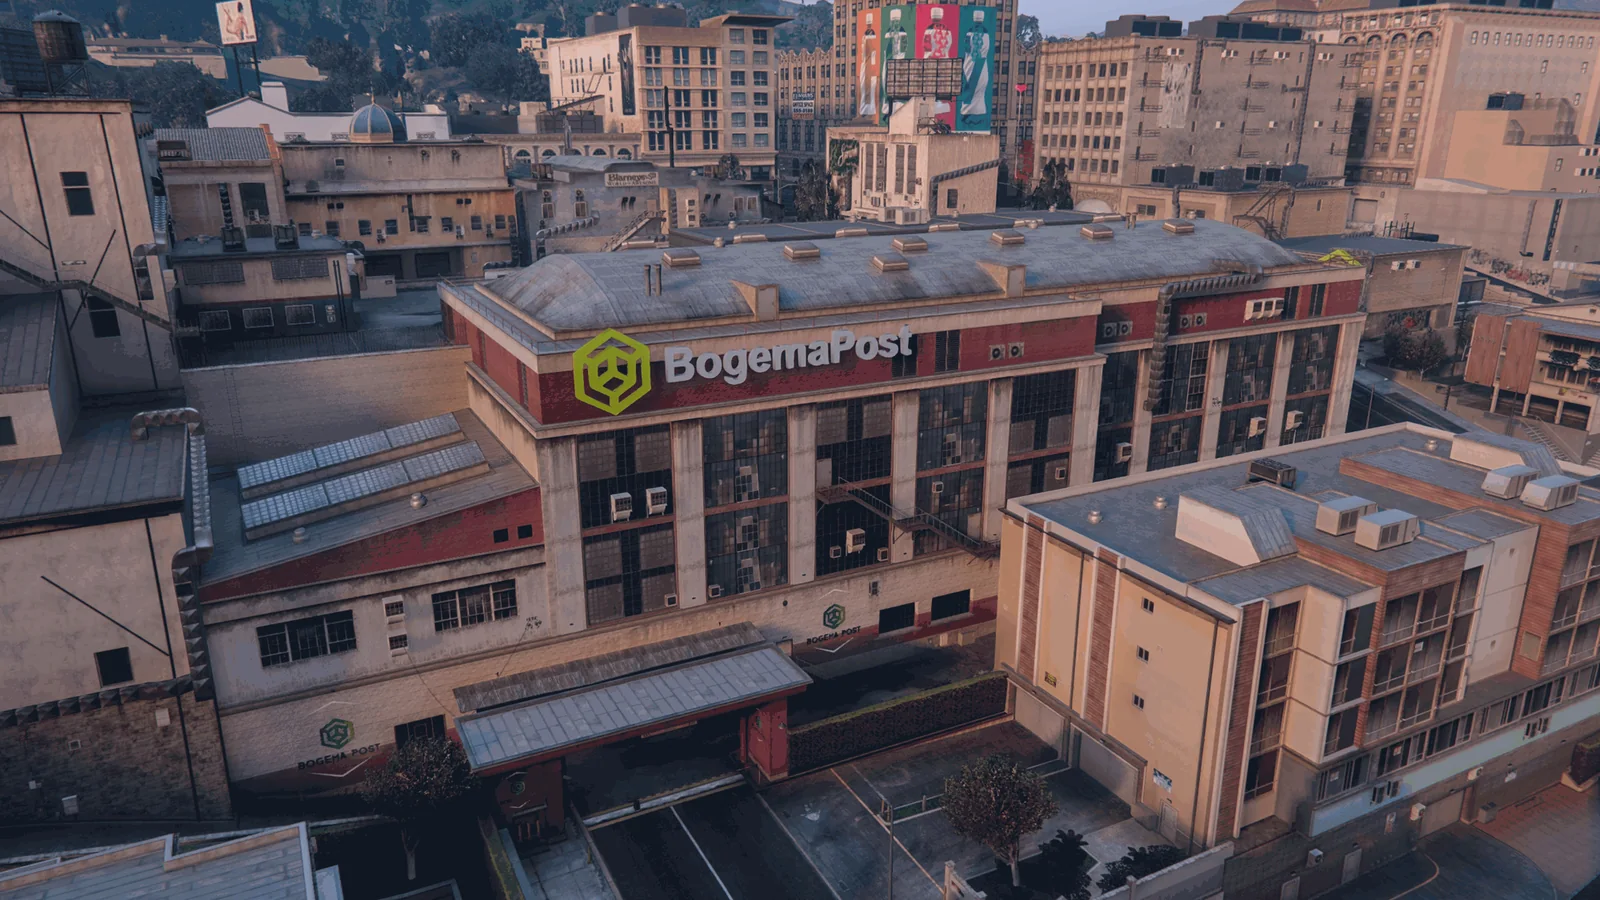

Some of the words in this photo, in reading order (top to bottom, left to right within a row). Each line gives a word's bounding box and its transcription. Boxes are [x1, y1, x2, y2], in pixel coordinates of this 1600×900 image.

[664, 324, 913, 386] BogemaPost
[806, 631, 839, 646] BOGEMA
[841, 625, 861, 636] POST
[297, 752, 347, 770] BOGEMA
[351, 743, 381, 756] POST
